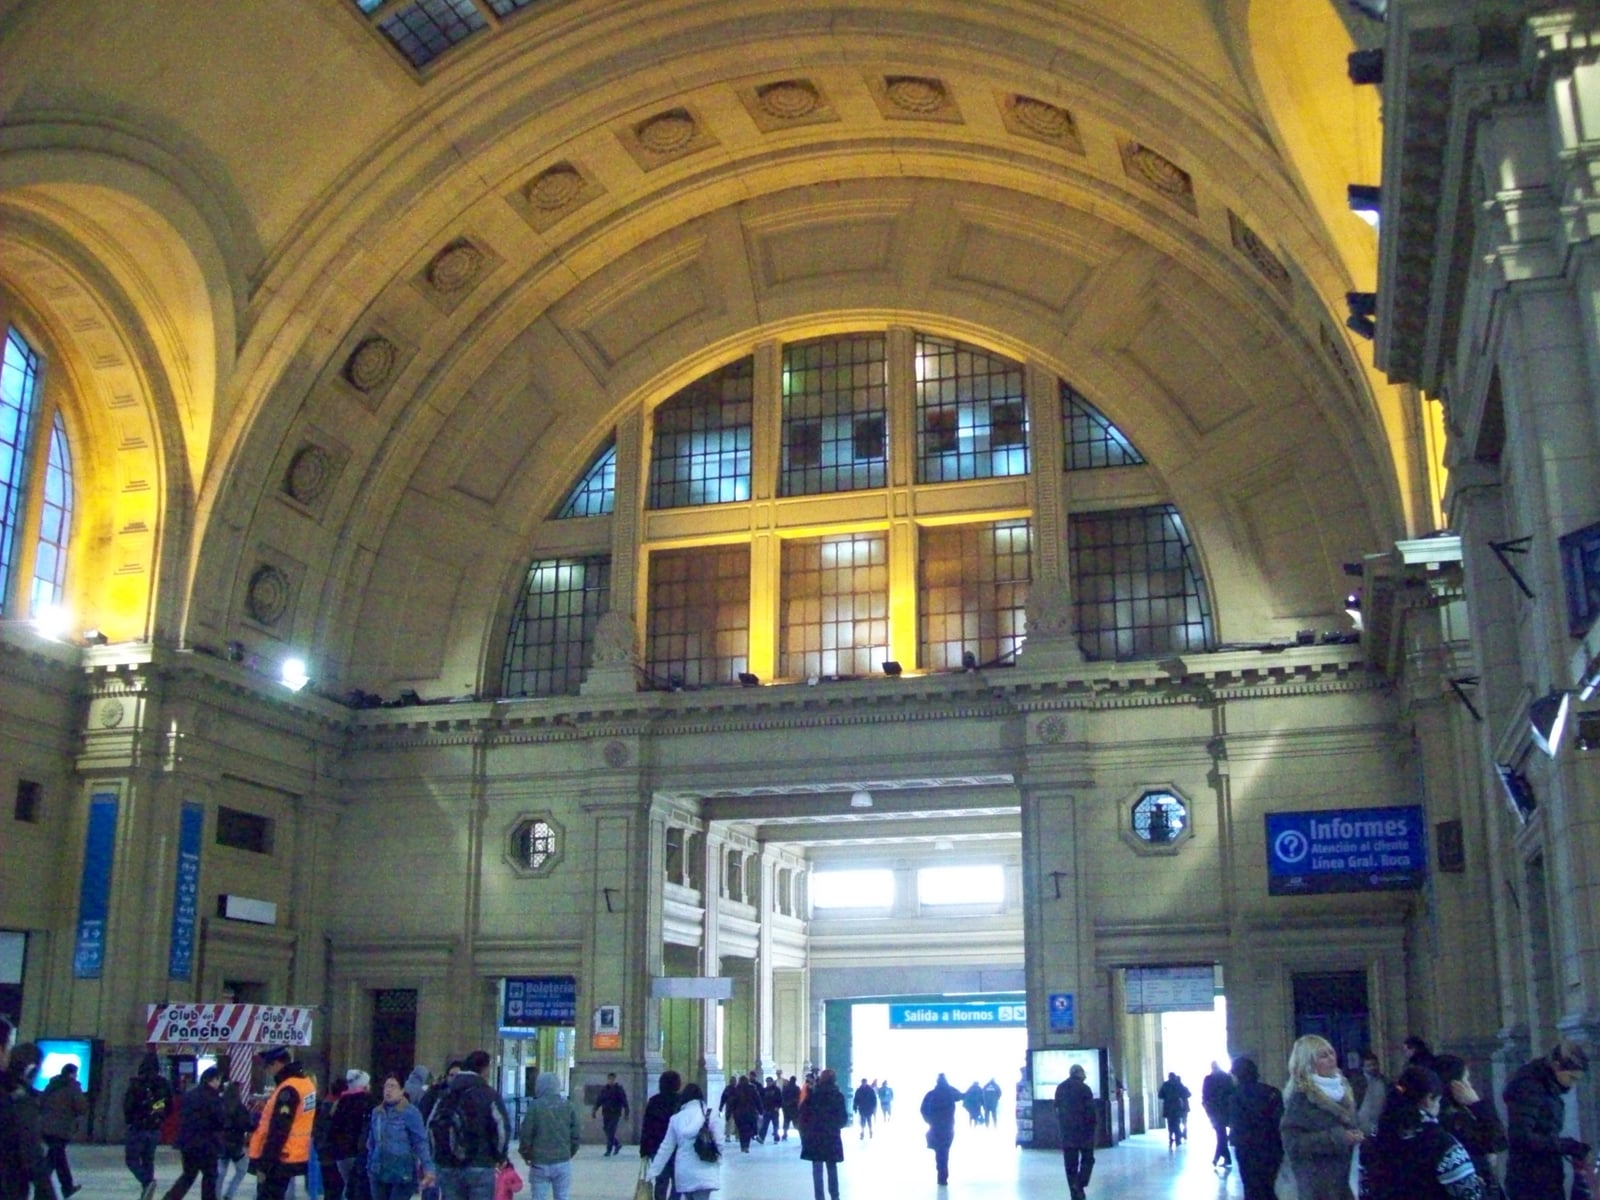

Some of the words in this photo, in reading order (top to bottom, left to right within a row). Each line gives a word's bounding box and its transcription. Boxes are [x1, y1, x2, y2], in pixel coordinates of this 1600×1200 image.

[1310, 818, 1408, 839] Informes
[1311, 841, 1358, 854] Atención
[1360, 840, 1371, 852] al
[1373, 839, 1409, 851] cliente
[1312, 855, 1345, 870] Línea
[1347, 853, 1378, 868] Gral.
[1381, 853, 1410, 867] Roca
[168, 1010, 198, 1021] Club
[262, 1012, 283, 1023] Club
[904, 1009, 938, 1022] Salida
[942, 1012, 949, 1021] a
[952, 1009, 994, 1021] Hornos
[168, 1024, 231, 1038] Pancho
[262, 1026, 304, 1041] Pancho
